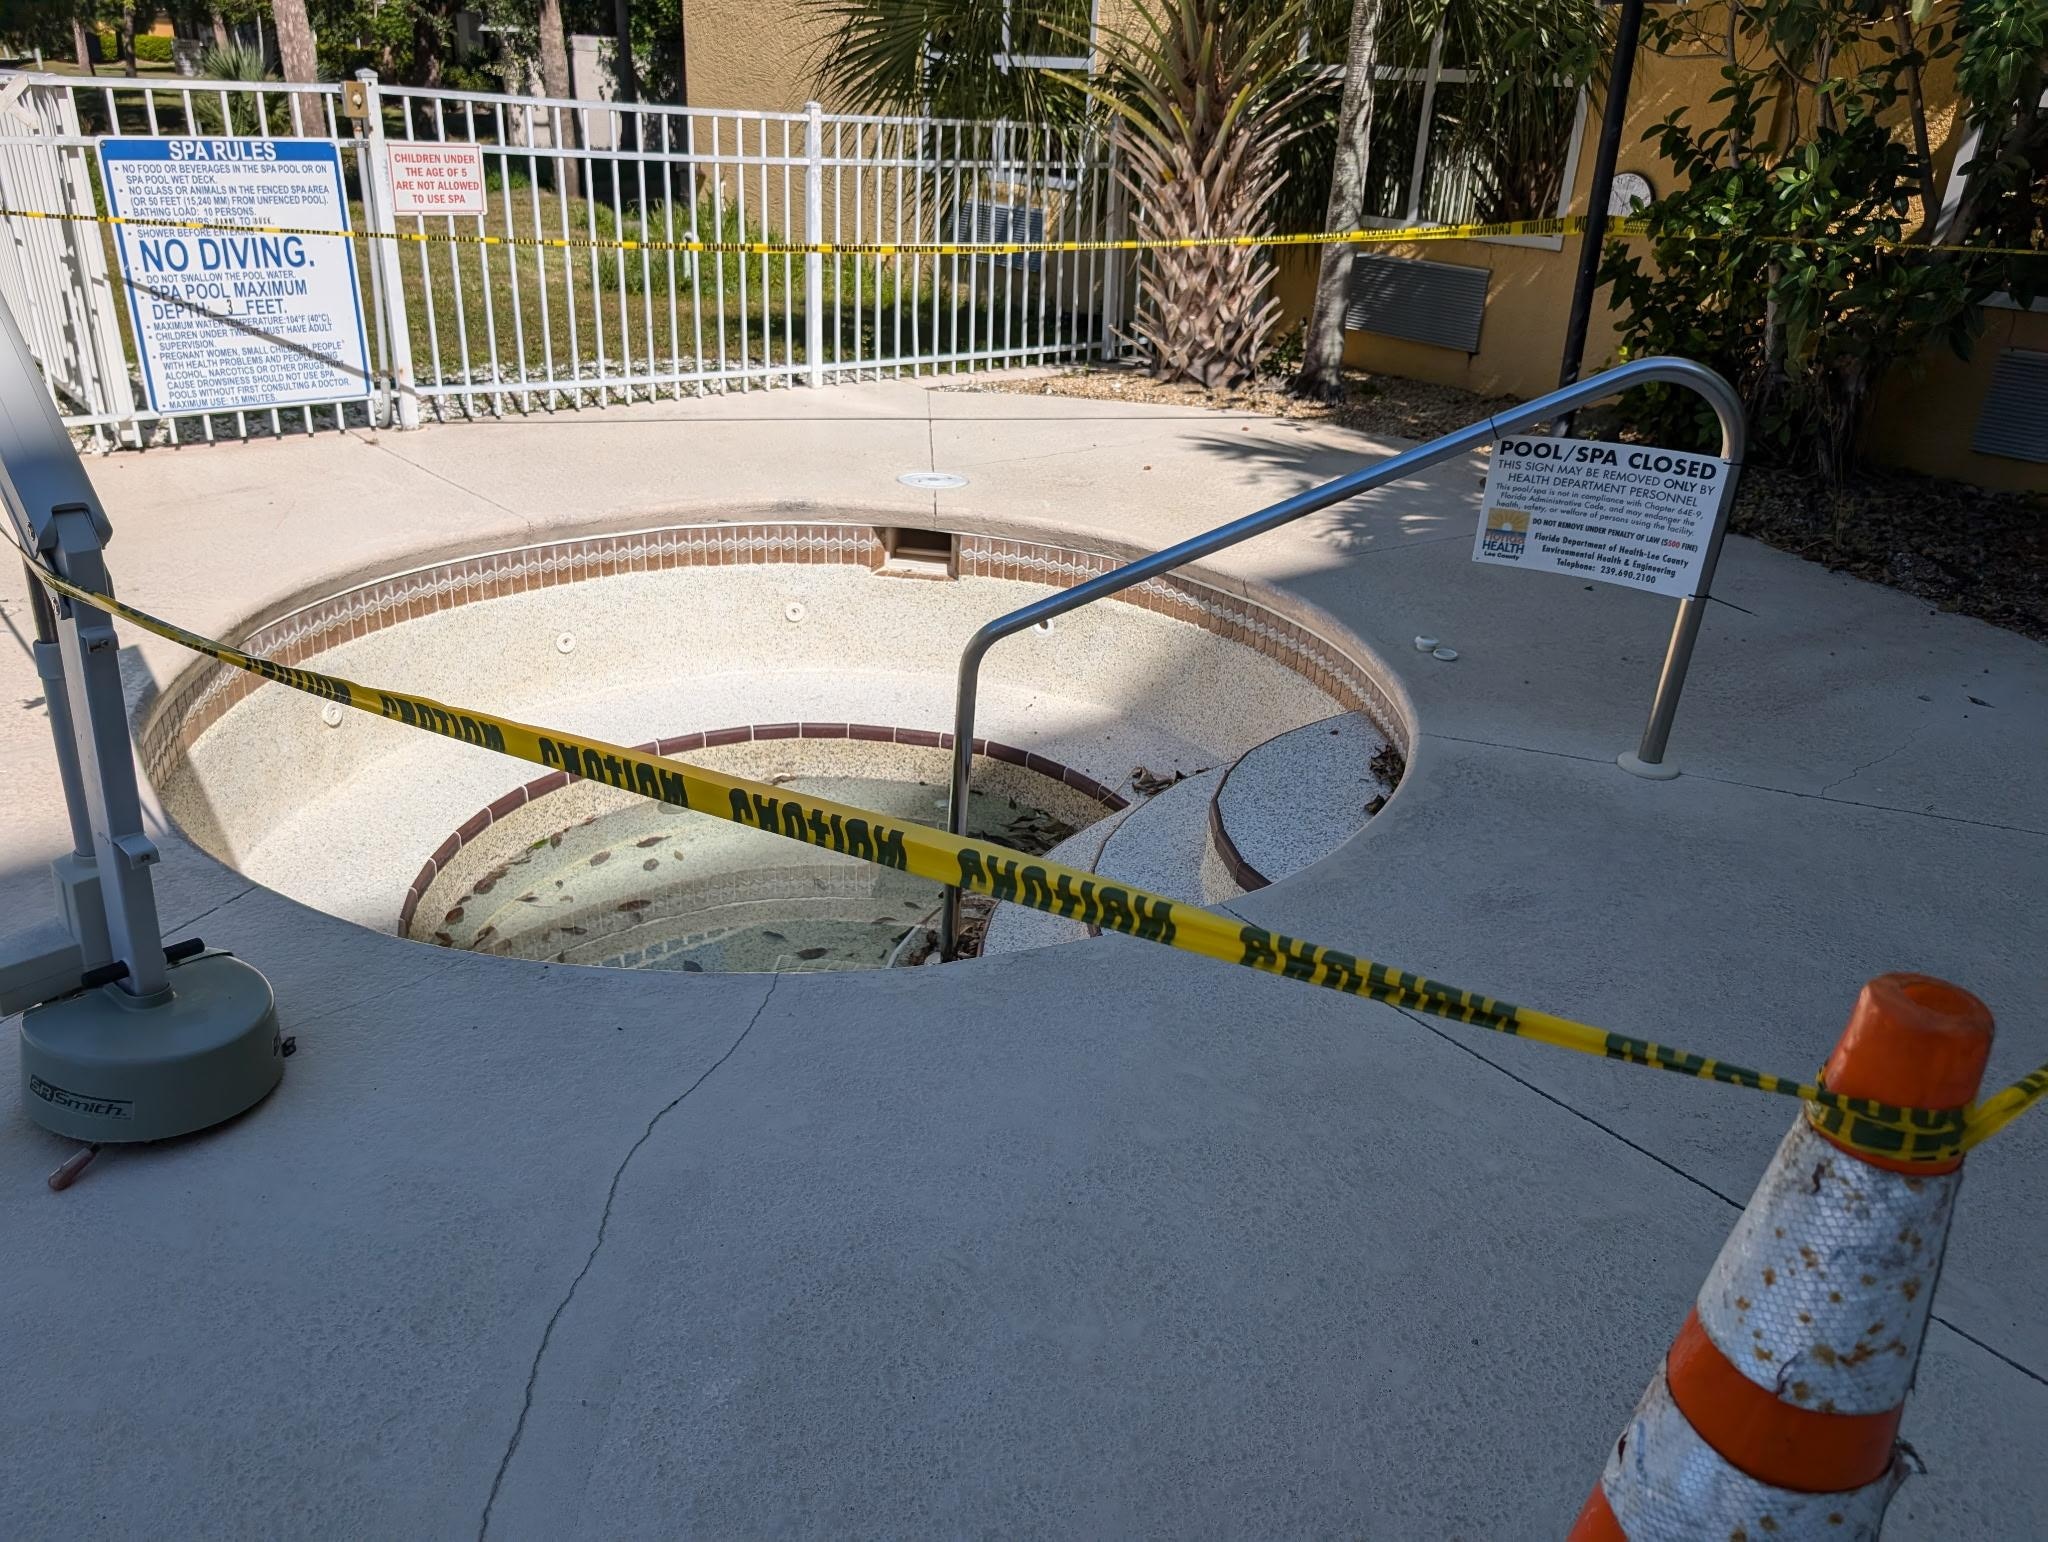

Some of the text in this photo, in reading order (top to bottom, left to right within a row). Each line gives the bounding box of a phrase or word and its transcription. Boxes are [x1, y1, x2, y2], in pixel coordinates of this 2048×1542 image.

[168, 141, 276, 160] SPA RULES
[394, 154, 475, 164] CHILDREN UNDER
[122, 164, 327, 173] NO FOOD OR BEVERAGES IN THE SPA POOL OR ON
[405, 168, 467, 176] THE AGE OF 5
[126, 176, 144, 184] SPA
[145, 176, 169, 184] POOL
[171, 176, 189, 184] WET
[396, 181, 479, 190] ARE NOT ALLOWED
[129, 186, 329, 195] NO GLASS OR ANIMALS IN THE FENCED SPA AREA
[413, 195, 466, 203] TO USE SPA
[131, 197, 146, 207] (OR
[148, 197, 158, 206] 50
[160, 197, 181, 206] FEET
[214, 196, 230, 206] MM)
[232, 196, 255, 205] FROM
[257, 196, 300, 205] UNFENCED
[302, 196, 328, 205] POOL).
[134, 207, 256, 216] BATHING LOAD: 10 PERSONS.
[140, 236, 314, 272] NO DIVING.
[147, 275, 159, 283] DO
[162, 275, 178, 283] NOT
[181, 273, 222, 282] SWALLOW
[226, 272, 241, 280] THE
[243, 272, 265, 280] POOL
[150, 280, 307, 301] SPA POOL MAXIMUM
[226, 299, 233, 315] 3
[246, 299, 287, 314] FEET.
[154, 321, 190, 330] MAXIMUM
[195, 320, 223, 329] WATER
[156, 324, 332, 341] CHILDREN UNDER TWELVE MUST HAVE ADULT
[169, 390, 197, 399] POOLS
[199, 388, 234, 397] WITHOUT
[238, 385, 260, 394] FIRST
[262, 382, 310, 392] CONSULTING
[1500, 440, 1716, 480] POOL/SPA CLOSED
[1499, 459, 1716, 495] THIS SIGN MAY BE REMOVED ONLY BY
[1508, 473, 1697, 507] HEALTH DEPARTMENT PERSONNEL
[1496, 482, 1510, 490] This
[1512, 485, 1547, 496] pool/spa
[1581, 493, 1624, 505] compliance
[1626, 499, 1642, 507] with
[1644, 502, 1675, 514] Chapter
[1677, 509, 1703, 519] 64E-9,
[1501, 492, 1526, 501] Florida
[1528, 496, 1581, 508] Administrative
[1585, 502, 1606, 511] Code,
[1609, 506, 1624, 514] and
[1626, 509, 1642, 517] may
[1645, 511, 1680, 524] endanger
[1496, 500, 1520, 509] health,
[1524, 503, 1547, 513] safety,
[1560, 508, 1587, 517] welfare
[1600, 514, 1628, 524] persons
[1631, 520, 1650, 529] using
[1558, 522, 1584, 531] REMOVE
[1585, 525, 1606, 534] UNDER
[1608, 529, 1635, 539] PENALTY
[1482, 541, 1525, 554] HEALTH
[1534, 533, 1560, 542] Florida
[1563, 536, 1606, 550] Department
[1619, 546, 1659, 560] Health-Lee
[1662, 554, 1688, 568] County
[1542, 545, 1594, 560] Environmental
[1597, 553, 1621, 564] Health
[1632, 560, 1676, 578] Engineering
[1557, 558, 1656, 583] Telephone: 239.690.2100
